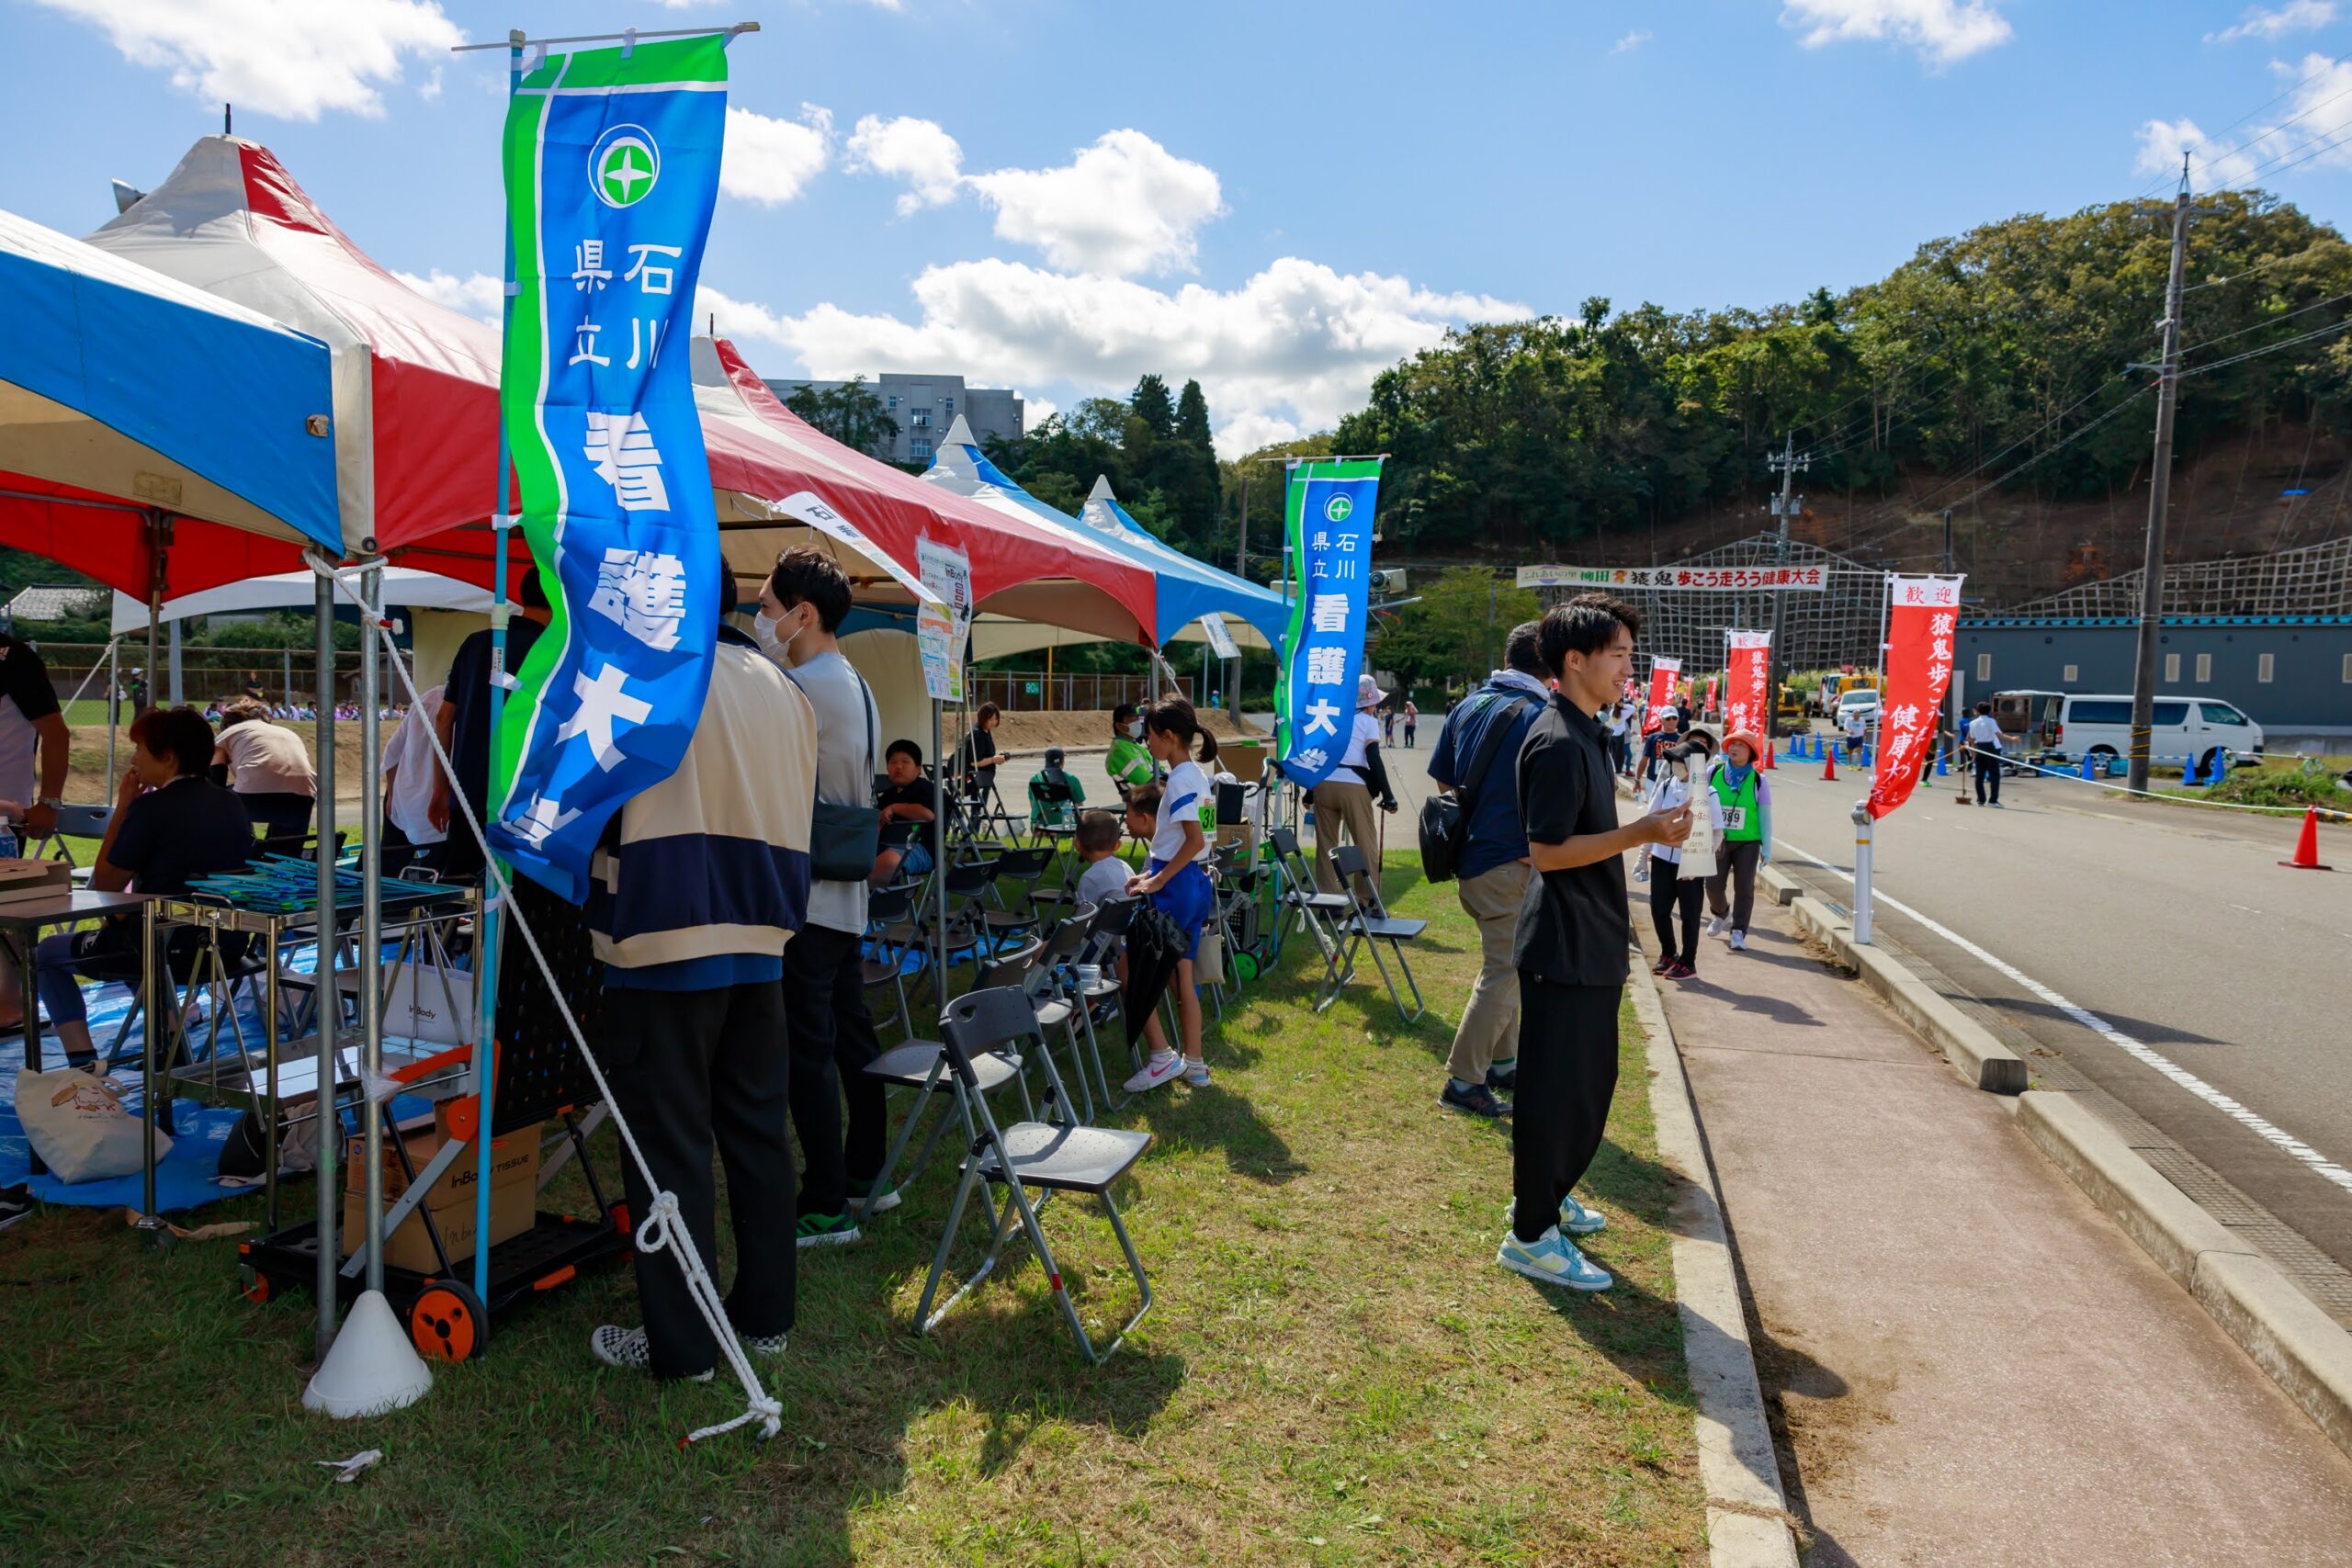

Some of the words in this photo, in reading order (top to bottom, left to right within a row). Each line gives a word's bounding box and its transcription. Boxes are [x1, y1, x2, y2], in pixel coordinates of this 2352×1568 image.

[569, 239, 613, 367] 県立
[624, 243, 682, 369] 石川
[1311, 531, 1330, 579] 県立
[1335, 533, 1359, 580] 石川
[1905, 585, 1953, 604] 歓迎
[1289, 593, 1350, 773] 看護大学
[451, 1167, 493, 1189] InBo
[496, 1155, 529, 1172] TISSUE
